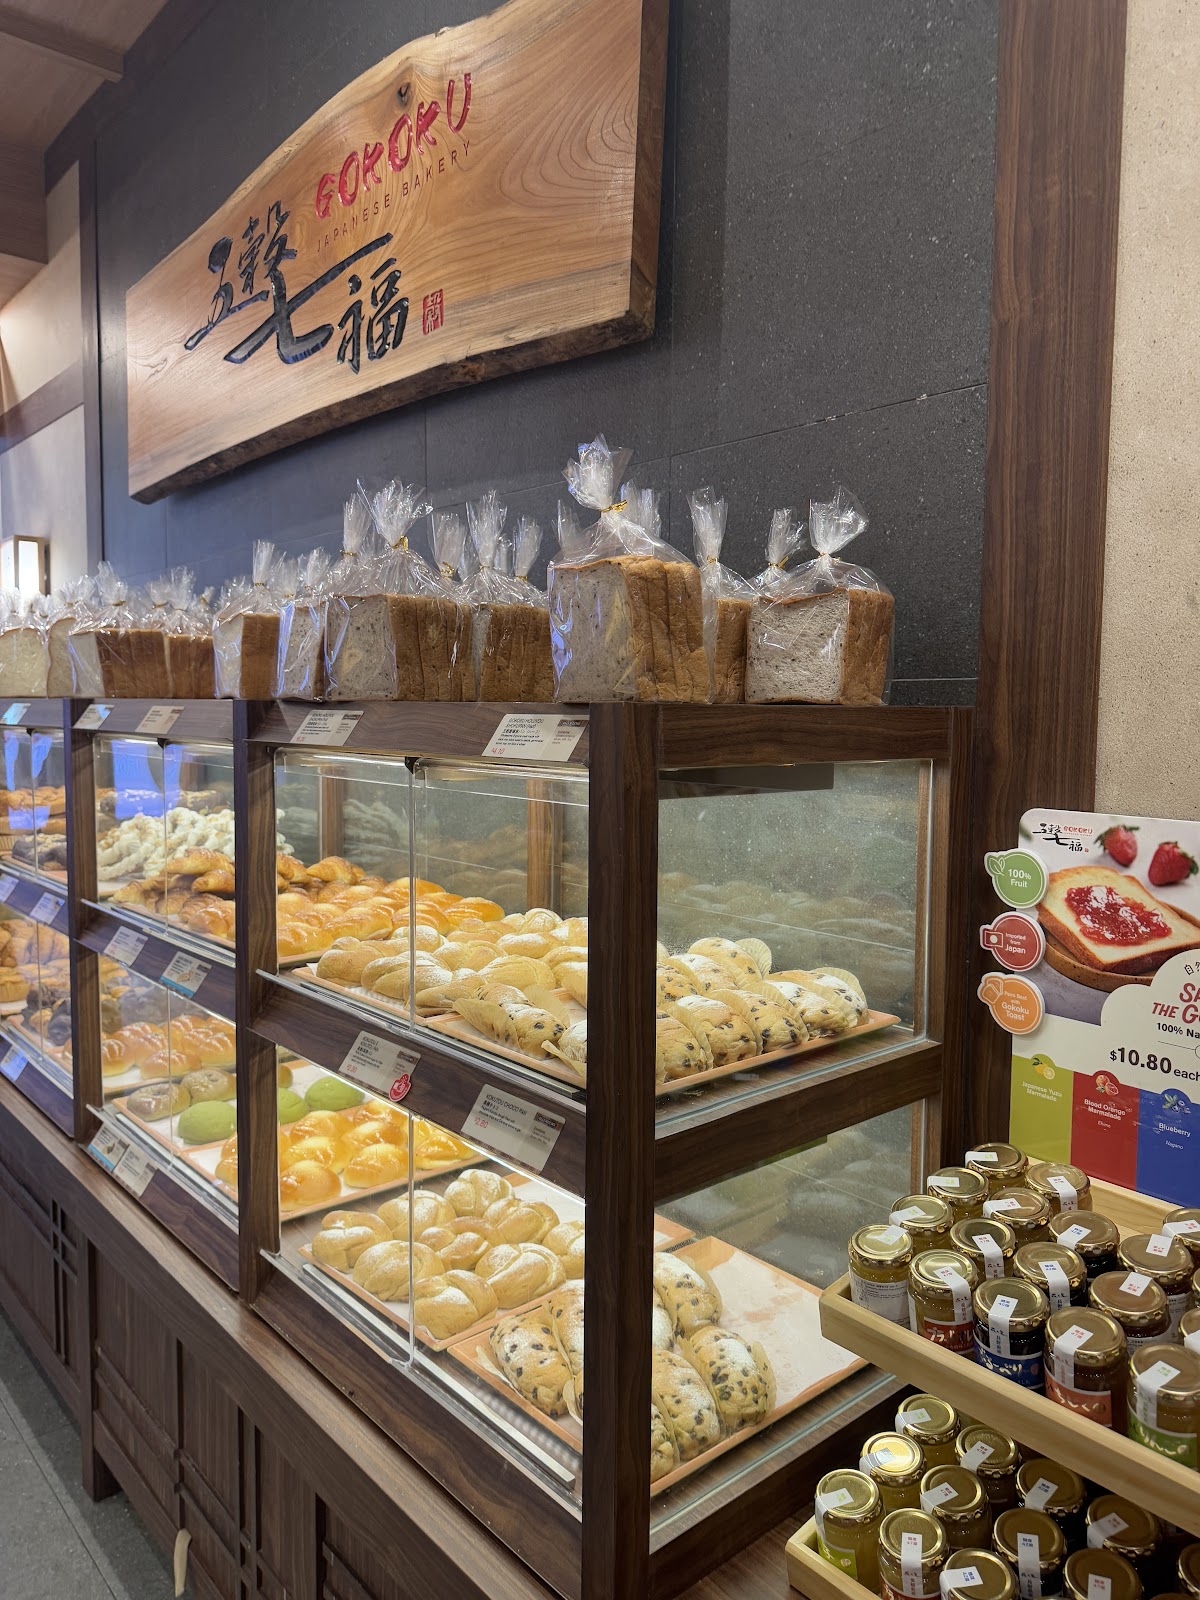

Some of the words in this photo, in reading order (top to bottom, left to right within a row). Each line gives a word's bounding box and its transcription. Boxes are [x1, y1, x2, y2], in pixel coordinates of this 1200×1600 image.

[315, 73, 471, 220] GOKOKU
[317, 194, 390, 252] JAPANESE
[402, 140, 470, 198] BAKERY
[1008, 869, 1032, 880] 100%
[1010, 879, 1028, 888] Fruit
[1006, 932, 1027, 940] Imported
[1005, 944, 1026, 954] Japan
[1002, 1002, 1030, 1015] Gokoku
[1006, 1010, 1025, 1021] Toast
[1152, 1002, 1179, 1019] THE
[1182, 1004, 1200, 1024] G
[1156, 1022, 1184, 1036] 100%
[1110, 1046, 1172, 1074] $10.80
[1174, 1068, 1200, 1082] each
[1022, 1081, 1048, 1093] Japanese
[1048, 1088, 1063, 1098] Yuzu
[1026, 1088, 1057, 1102] Marmalade
[504, 1100, 520, 1112] CHOCO
[1084, 1098, 1102, 1109] Blood
[1103, 1104, 1126, 1116] Orange
[1088, 1106, 1121, 1121] Marmalade
[1158, 1122, 1191, 1138] Blueberry
[1166, 1140, 1184, 1150] Nagano
